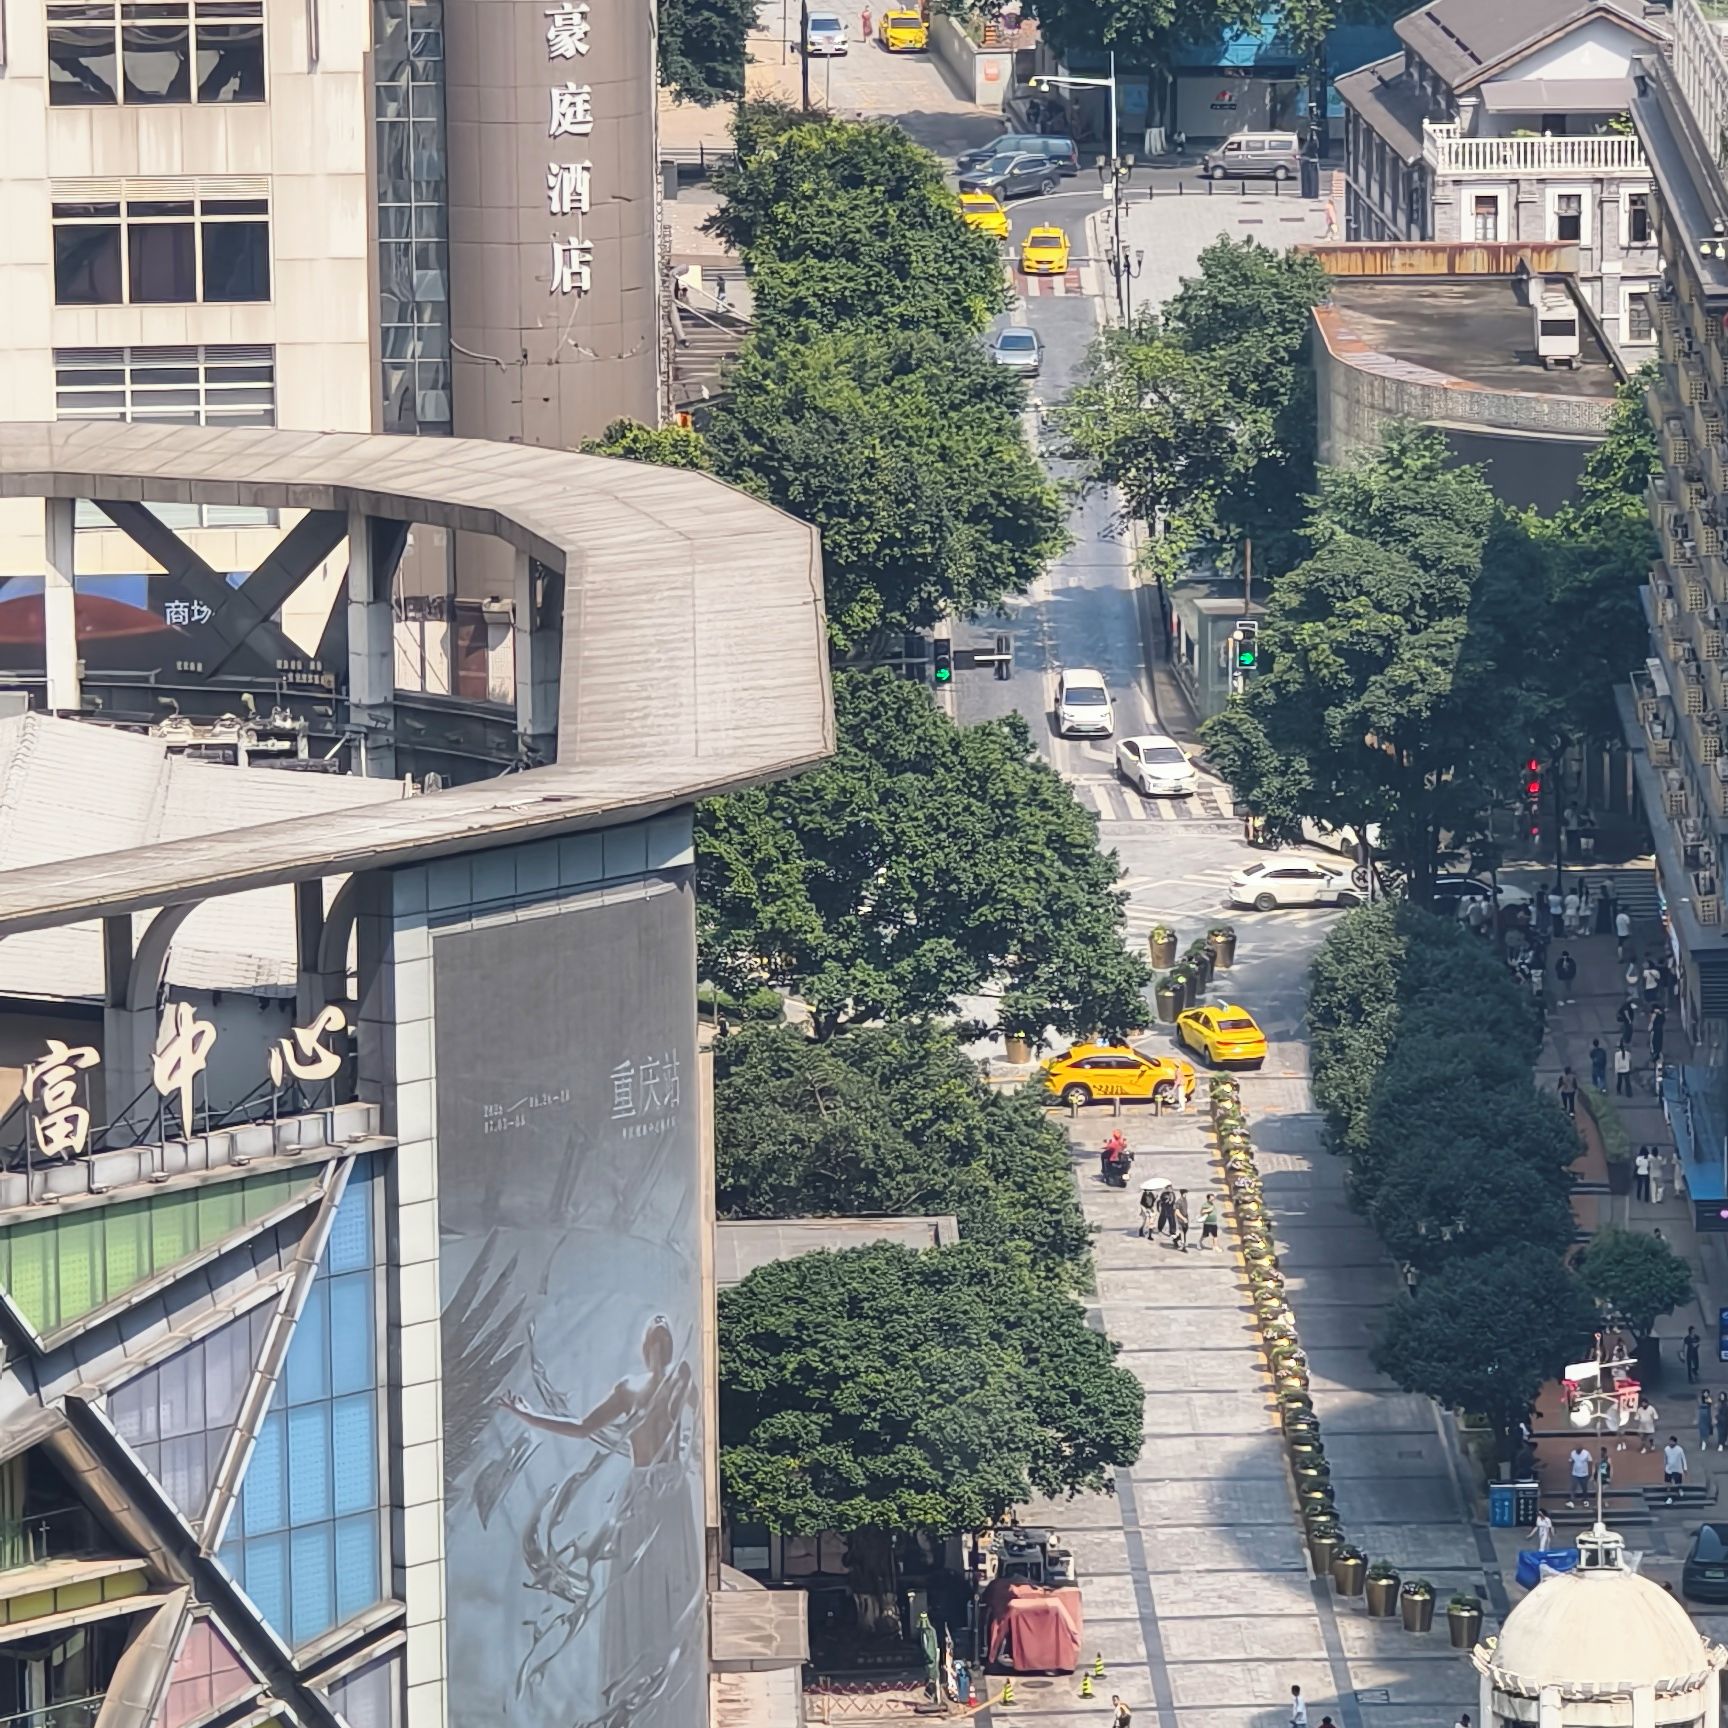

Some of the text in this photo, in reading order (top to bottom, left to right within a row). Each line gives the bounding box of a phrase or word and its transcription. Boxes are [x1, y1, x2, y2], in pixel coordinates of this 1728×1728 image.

[544, 2, 594, 295] 豪庭酒店
[610, 1048, 680, 1120] 重庆站
